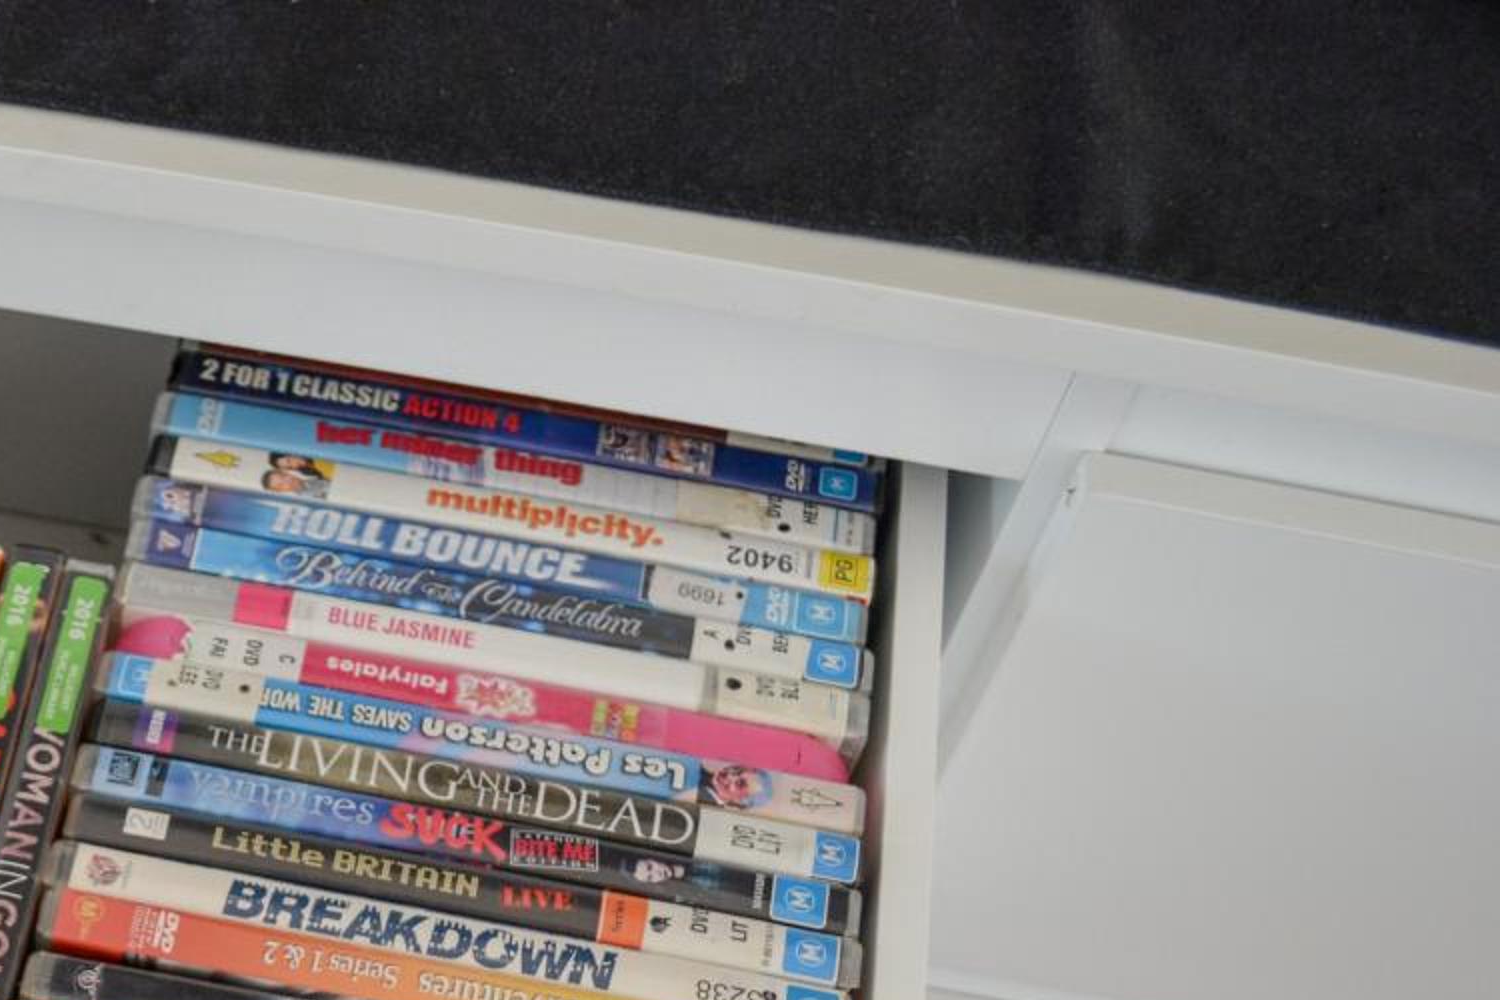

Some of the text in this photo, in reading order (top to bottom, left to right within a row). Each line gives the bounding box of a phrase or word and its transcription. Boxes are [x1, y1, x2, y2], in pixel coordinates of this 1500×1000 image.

[200, 358, 522, 433] 2 FOR 1 CLASSIC ACTION 4
[270, 501, 591, 583] ROLL BOUNCE
[726, 544, 793, 574] 9402
[275, 545, 434, 596] Behind
[6, 584, 31, 626] 2016
[68, 598, 94, 641] 2016
[328, 606, 477, 648] BLUE JASMINE
[325, 655, 448, 695] Fairytales
[260, 687, 687, 791] Les Patterson SAVES THE WOR
[208, 725, 264, 753] THE
[256, 729, 460, 801] LIVING
[456, 766, 526, 794] AND
[533, 780, 695, 846] DEAD
[191, 769, 508, 861] vampires SUCK
[212, 827, 573, 913] Little BRITAIN LIVE
[563, 842, 596, 861] ME
[223, 876, 619, 992] BREAKDOWN
[262, 941, 279, 966] 2
[328, 954, 401, 990] Series
